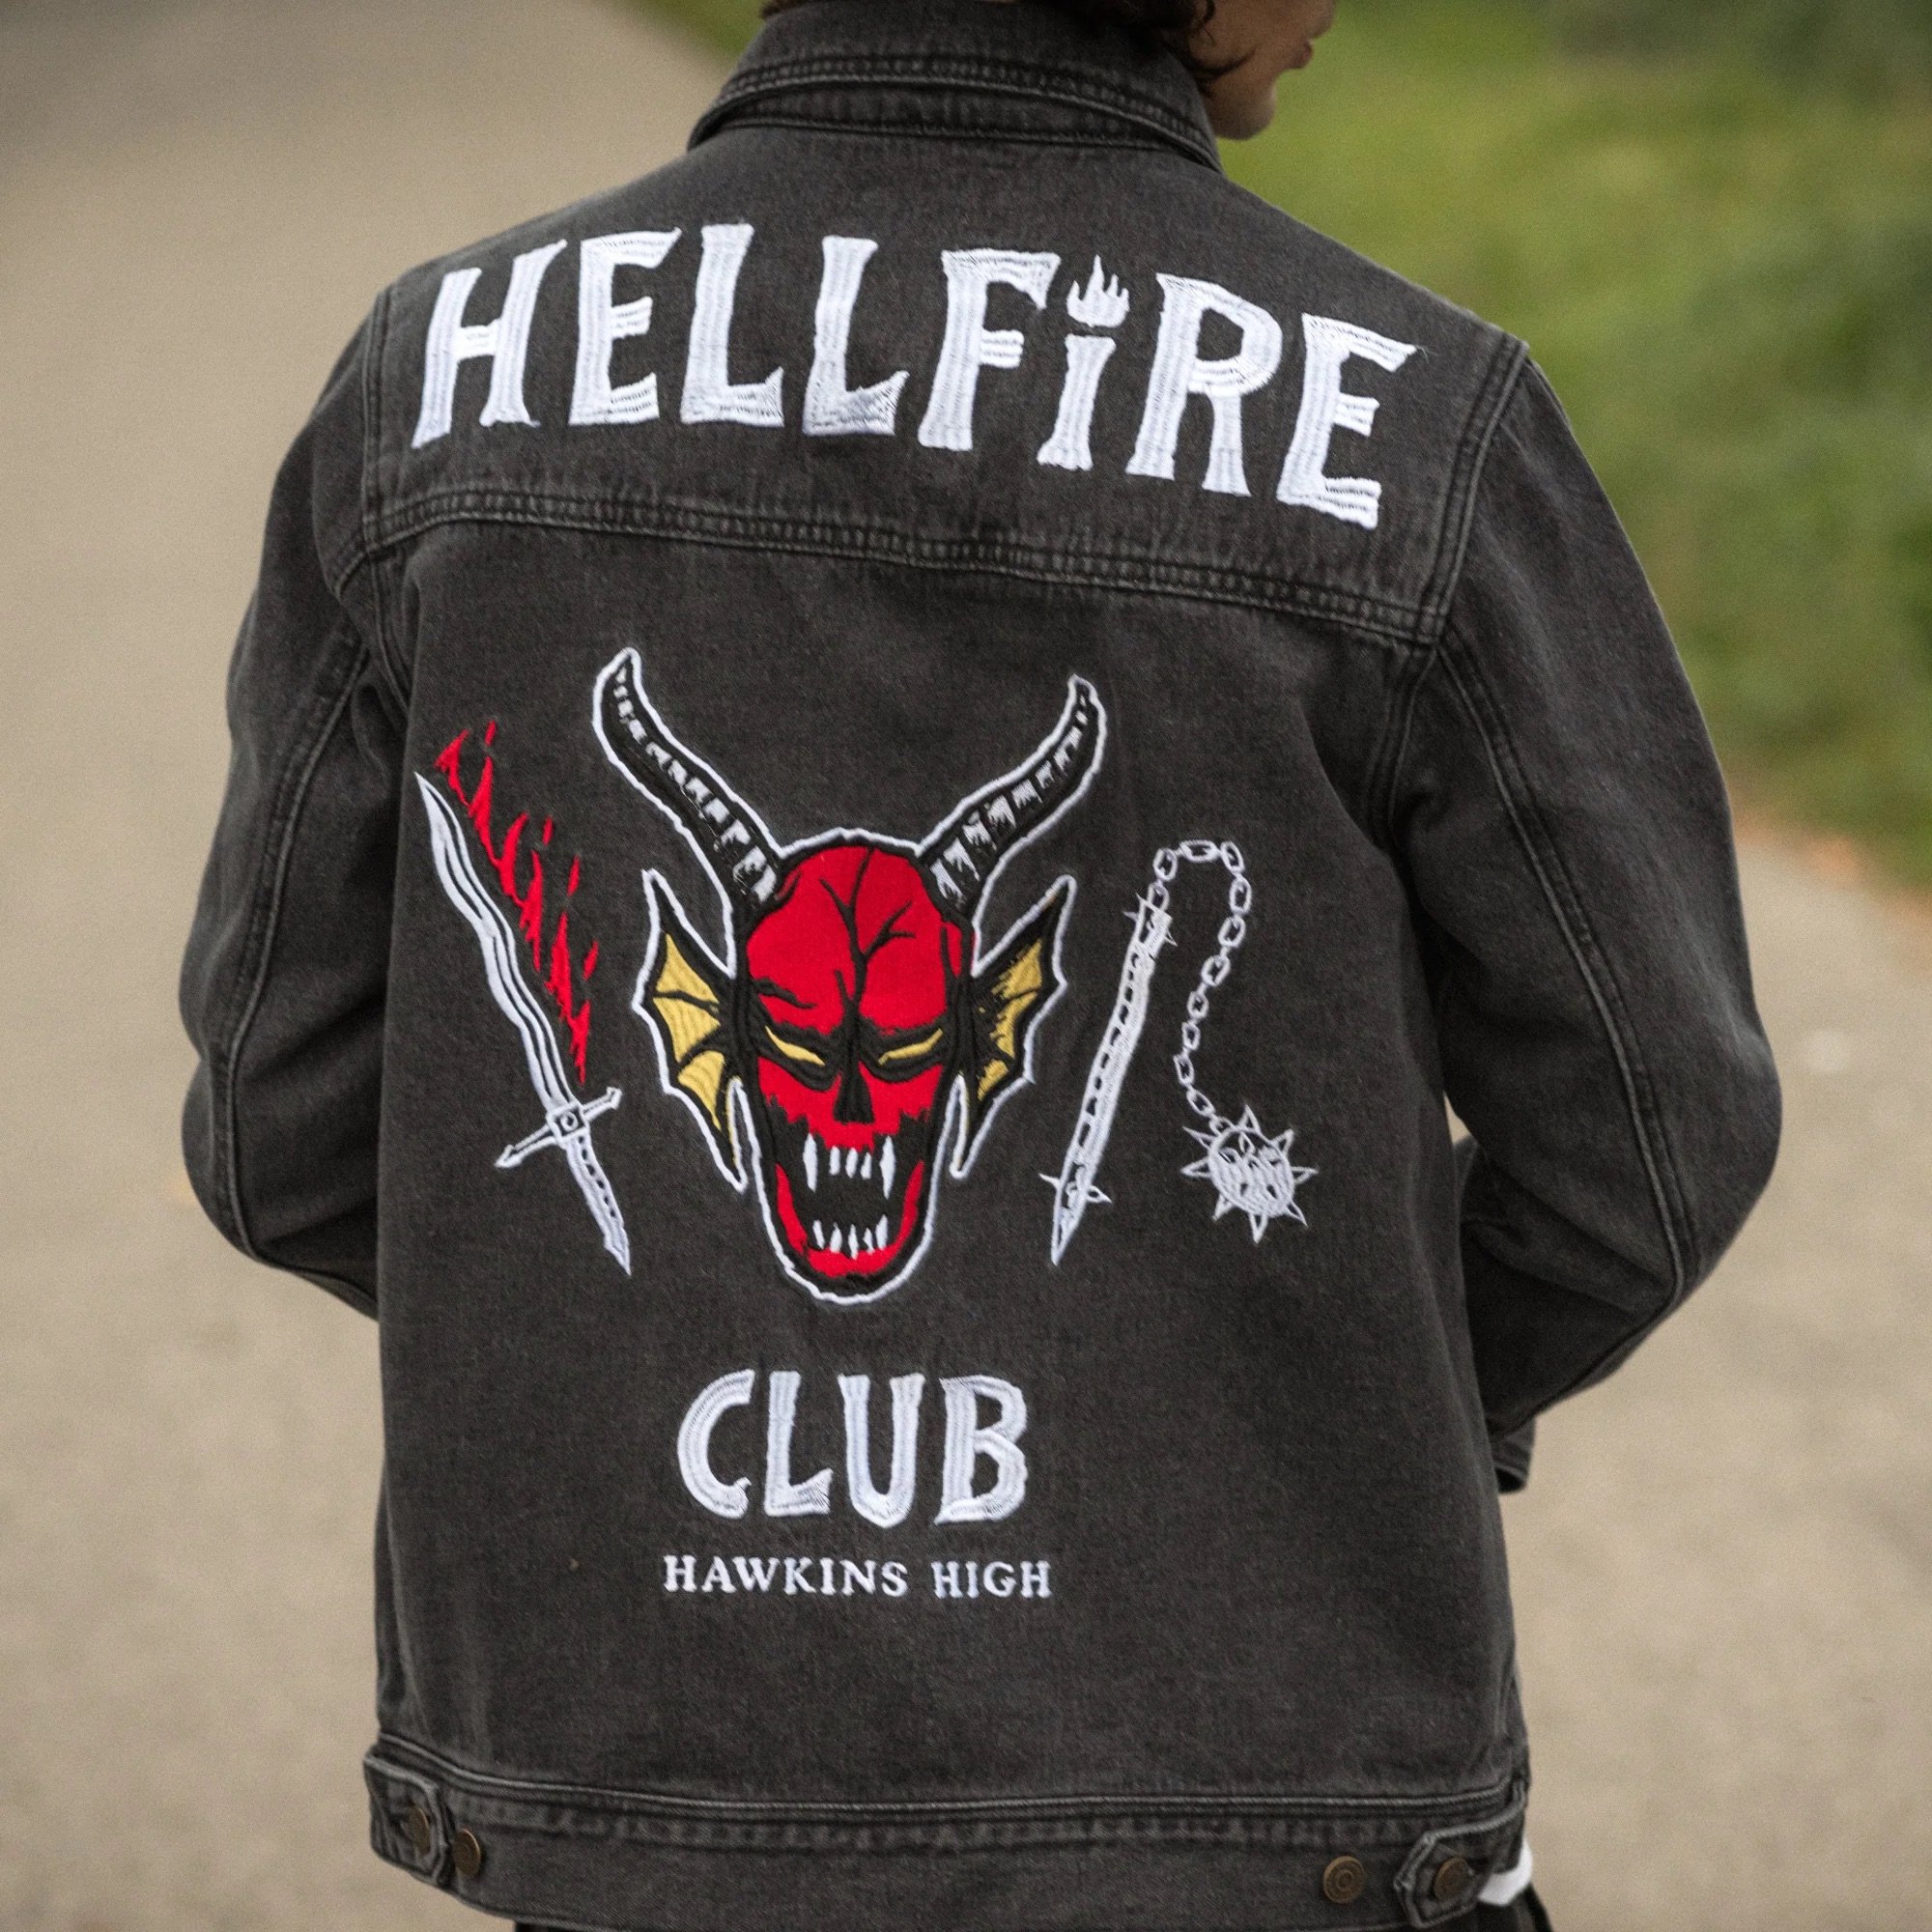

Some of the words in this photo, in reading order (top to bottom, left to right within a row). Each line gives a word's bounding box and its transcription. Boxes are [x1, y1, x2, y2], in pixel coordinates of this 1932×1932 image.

[677, 1368, 1029, 1529] CLUB
[663, 1554, 908, 1598] HAWKINS
[930, 1560, 1053, 1599] HIGH
